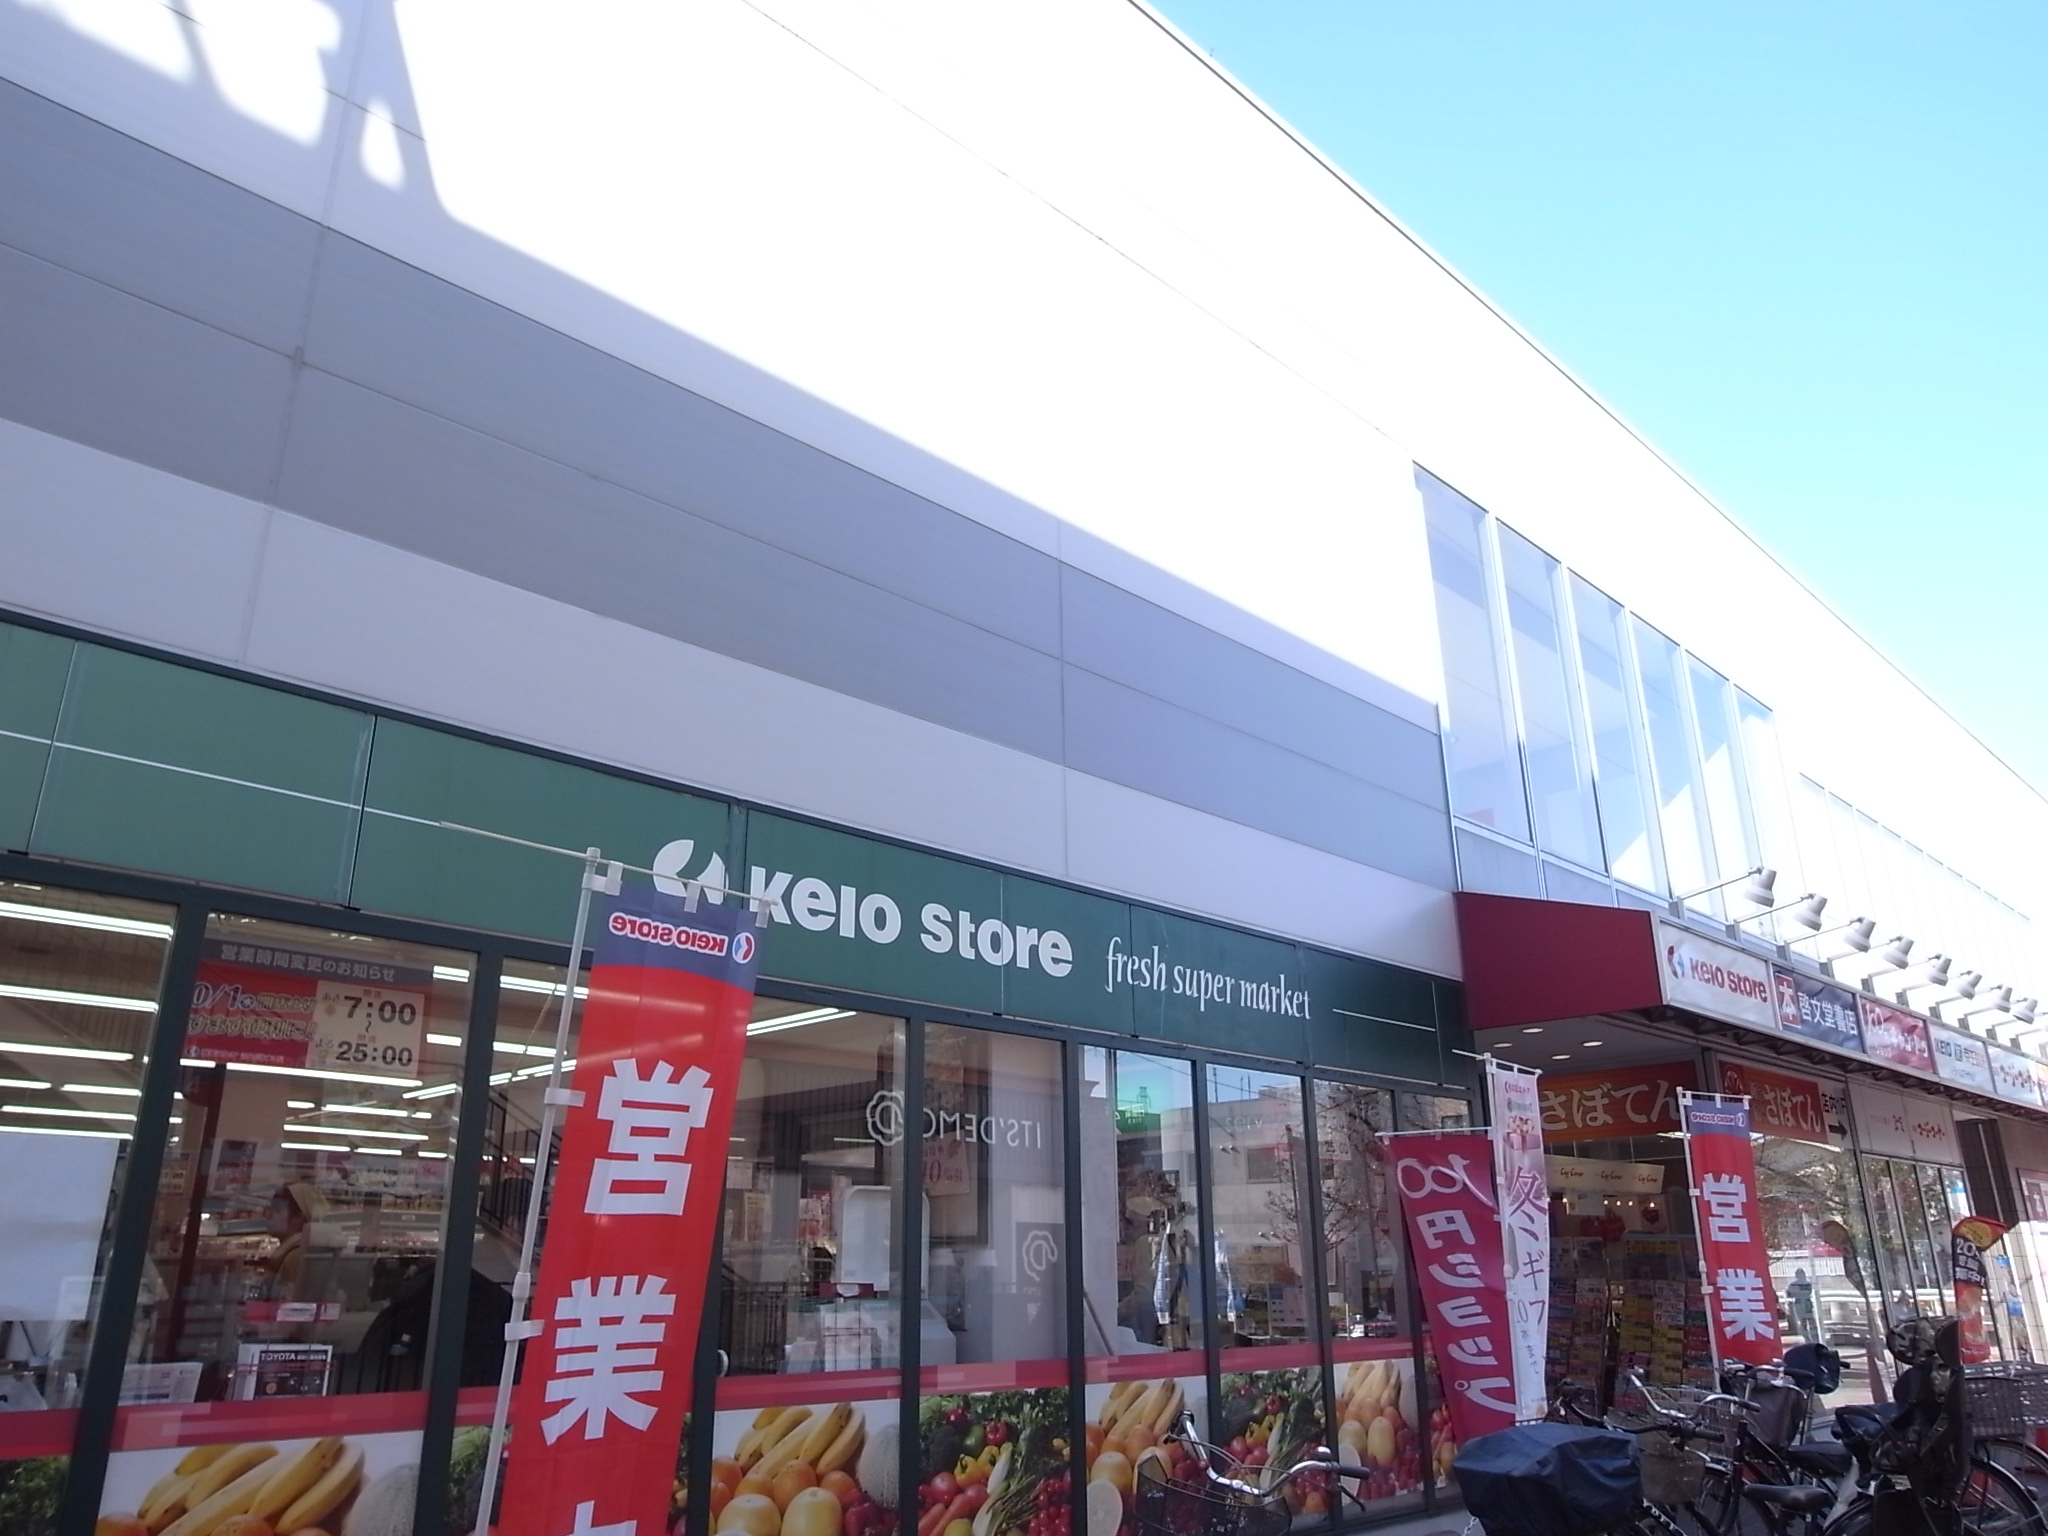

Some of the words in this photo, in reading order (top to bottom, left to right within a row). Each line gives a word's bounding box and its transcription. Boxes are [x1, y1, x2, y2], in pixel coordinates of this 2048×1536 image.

[220, 944, 396, 982] 営業時間変更のお知らせ
[1105, 936, 1167, 993] fresh
[1238, 974, 1312, 1020] market
[343, 994, 417, 1026] 7:00
[335, 1040, 413, 1067] 25:00
[1541, 1079, 1680, 1131] さぼてん
[1763, 1084, 1821, 1134] さぼてん
[1701, 1172, 1776, 1341] 営業
[540, 1057, 714, 1536] 営業
[261, 1353, 296, 1361] TOYOTA
